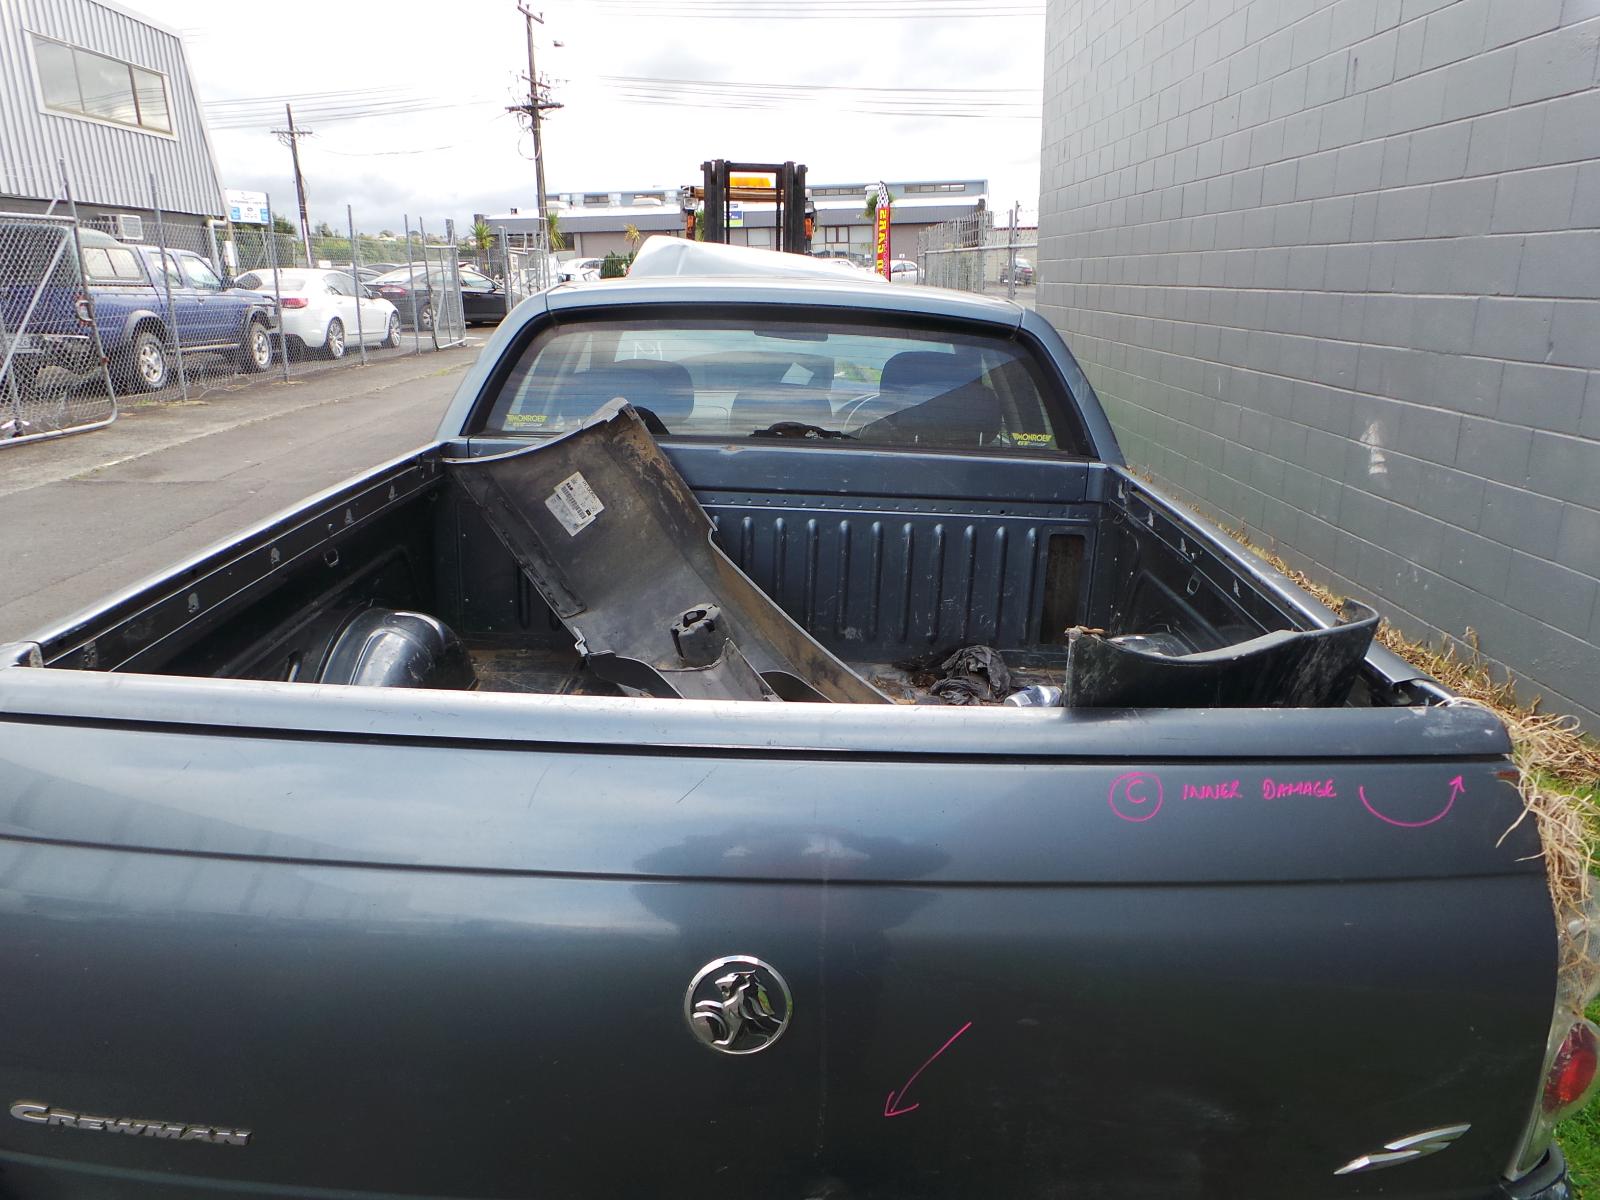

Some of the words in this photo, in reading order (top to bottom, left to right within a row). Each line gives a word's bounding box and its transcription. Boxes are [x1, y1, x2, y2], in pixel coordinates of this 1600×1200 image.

[508, 415, 546, 423] MONROE
[1014, 433, 1051, 442] MONROE
[1182, 780, 1240, 800] INNER
[1263, 778, 1336, 800] DAMAGE
